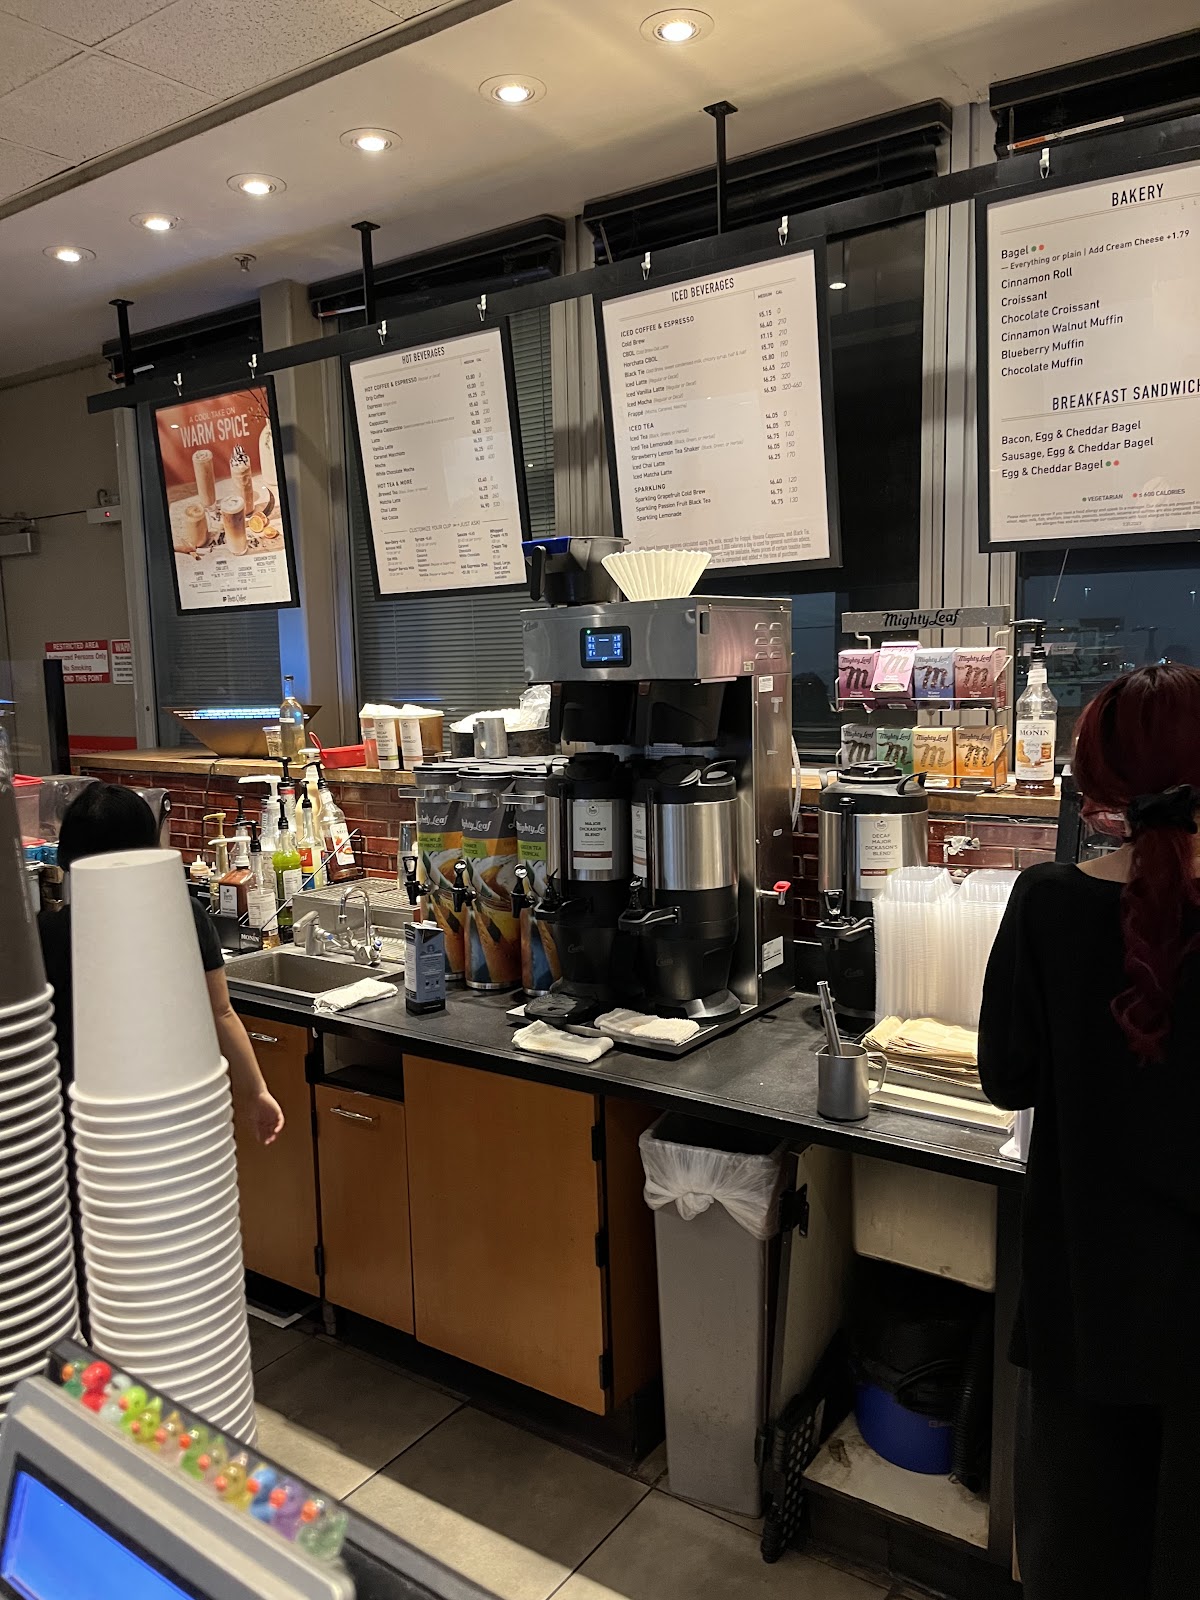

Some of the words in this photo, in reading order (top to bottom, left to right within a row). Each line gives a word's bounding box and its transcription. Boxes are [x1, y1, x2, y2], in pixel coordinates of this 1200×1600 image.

[1111, 183, 1164, 207] BAKERY
[1001, 245, 1029, 260] Bagel
[1010, 256, 1050, 271] Everything
[1062, 250, 1082, 262] plain
[1088, 245, 1104, 255] Add
[1105, 240, 1132, 251] Cream
[1134, 234, 1164, 246] Cheese
[1166, 229, 1190, 241] +1.79
[1001, 273, 1050, 289] Cinnamon
[1053, 267, 1073, 280] Roll
[671, 288, 688, 302] ICED
[690, 277, 735, 298] BEVERAGES
[1001, 291, 1048, 307] Croissant
[759, 310, 772, 318] $5.15
[1001, 309, 1049, 325] Chocolate
[1051, 300, 1100, 316] Croissant
[620, 329, 634, 337] ICED
[634, 324, 656, 334] COFFEE
[663, 316, 694, 328] ESPRESSO
[1001, 327, 1050, 342] Cinnamon
[1052, 320, 1087, 334] Walnut
[1090, 314, 1123, 327] Muffin
[622, 350, 635, 358] CBOL
[759, 320, 773, 329] $6.40
[761, 342, 774, 350] $5.70
[401, 353, 412, 364] HOT
[413, 346, 445, 362] BEVERAGES
[761, 353, 775, 361] $5.80
[1001, 344, 1049, 360] Blueberry
[1052, 339, 1084, 352] Muffin
[623, 359, 644, 368] Horchata
[1001, 363, 1049, 377] Chocolate
[1051, 357, 1083, 370] Muffin
[373, 383, 389, 391] COFFEE
[395, 377, 417, 387] ESPRESSO
[636, 388, 652, 396] Vanilla
[780, 361, 791, 369] 220
[1052, 387, 1128, 411] BREAKFAST
[194, 413, 211, 422] COOL
[211, 410, 225, 419] TAKE
[226, 407, 236, 415] ON
[180, 421, 216, 448] WARM
[217, 414, 250, 441] SPICE
[628, 424, 642, 432] ICED
[1001, 434, 1033, 445] Bacon,
[1035, 431, 1053, 442] Egg
[1056, 430, 1063, 438] &
[1066, 425, 1109, 438] Cheddar
[1111, 421, 1141, 433] Bagel
[649, 440, 673, 448] Lemonade
[1001, 450, 1045, 461] Sausage,
[1047, 448, 1065, 457] Egg
[1068, 445, 1075, 454] &
[1077, 440, 1121, 453] Cheddar
[1124, 437, 1154, 449] Bagel
[1001, 469, 1019, 479] Egg
[1021, 467, 1029, 476] &
[1031, 463, 1072, 475] Cheddar
[1074, 460, 1103, 471] Bagel
[634, 484, 666, 493] SPARKLING
[635, 495, 657, 503] Sparkling
[657, 492, 680, 501] Grapefruit
[1087, 494, 1123, 502] VEGETARIAN
[636, 514, 658, 522] Sparkling
[658, 511, 682, 519] Lemonade
[881, 612, 930, 629] Mighty
[928, 609, 961, 627] Leaf
[52, 642, 84, 650] RESTRICTED
[71, 664, 92, 672] Smoking
[430, 814, 448, 826] Leaf
[473, 820, 492, 832] Leaf
[240, 933, 260, 942] MONIN
